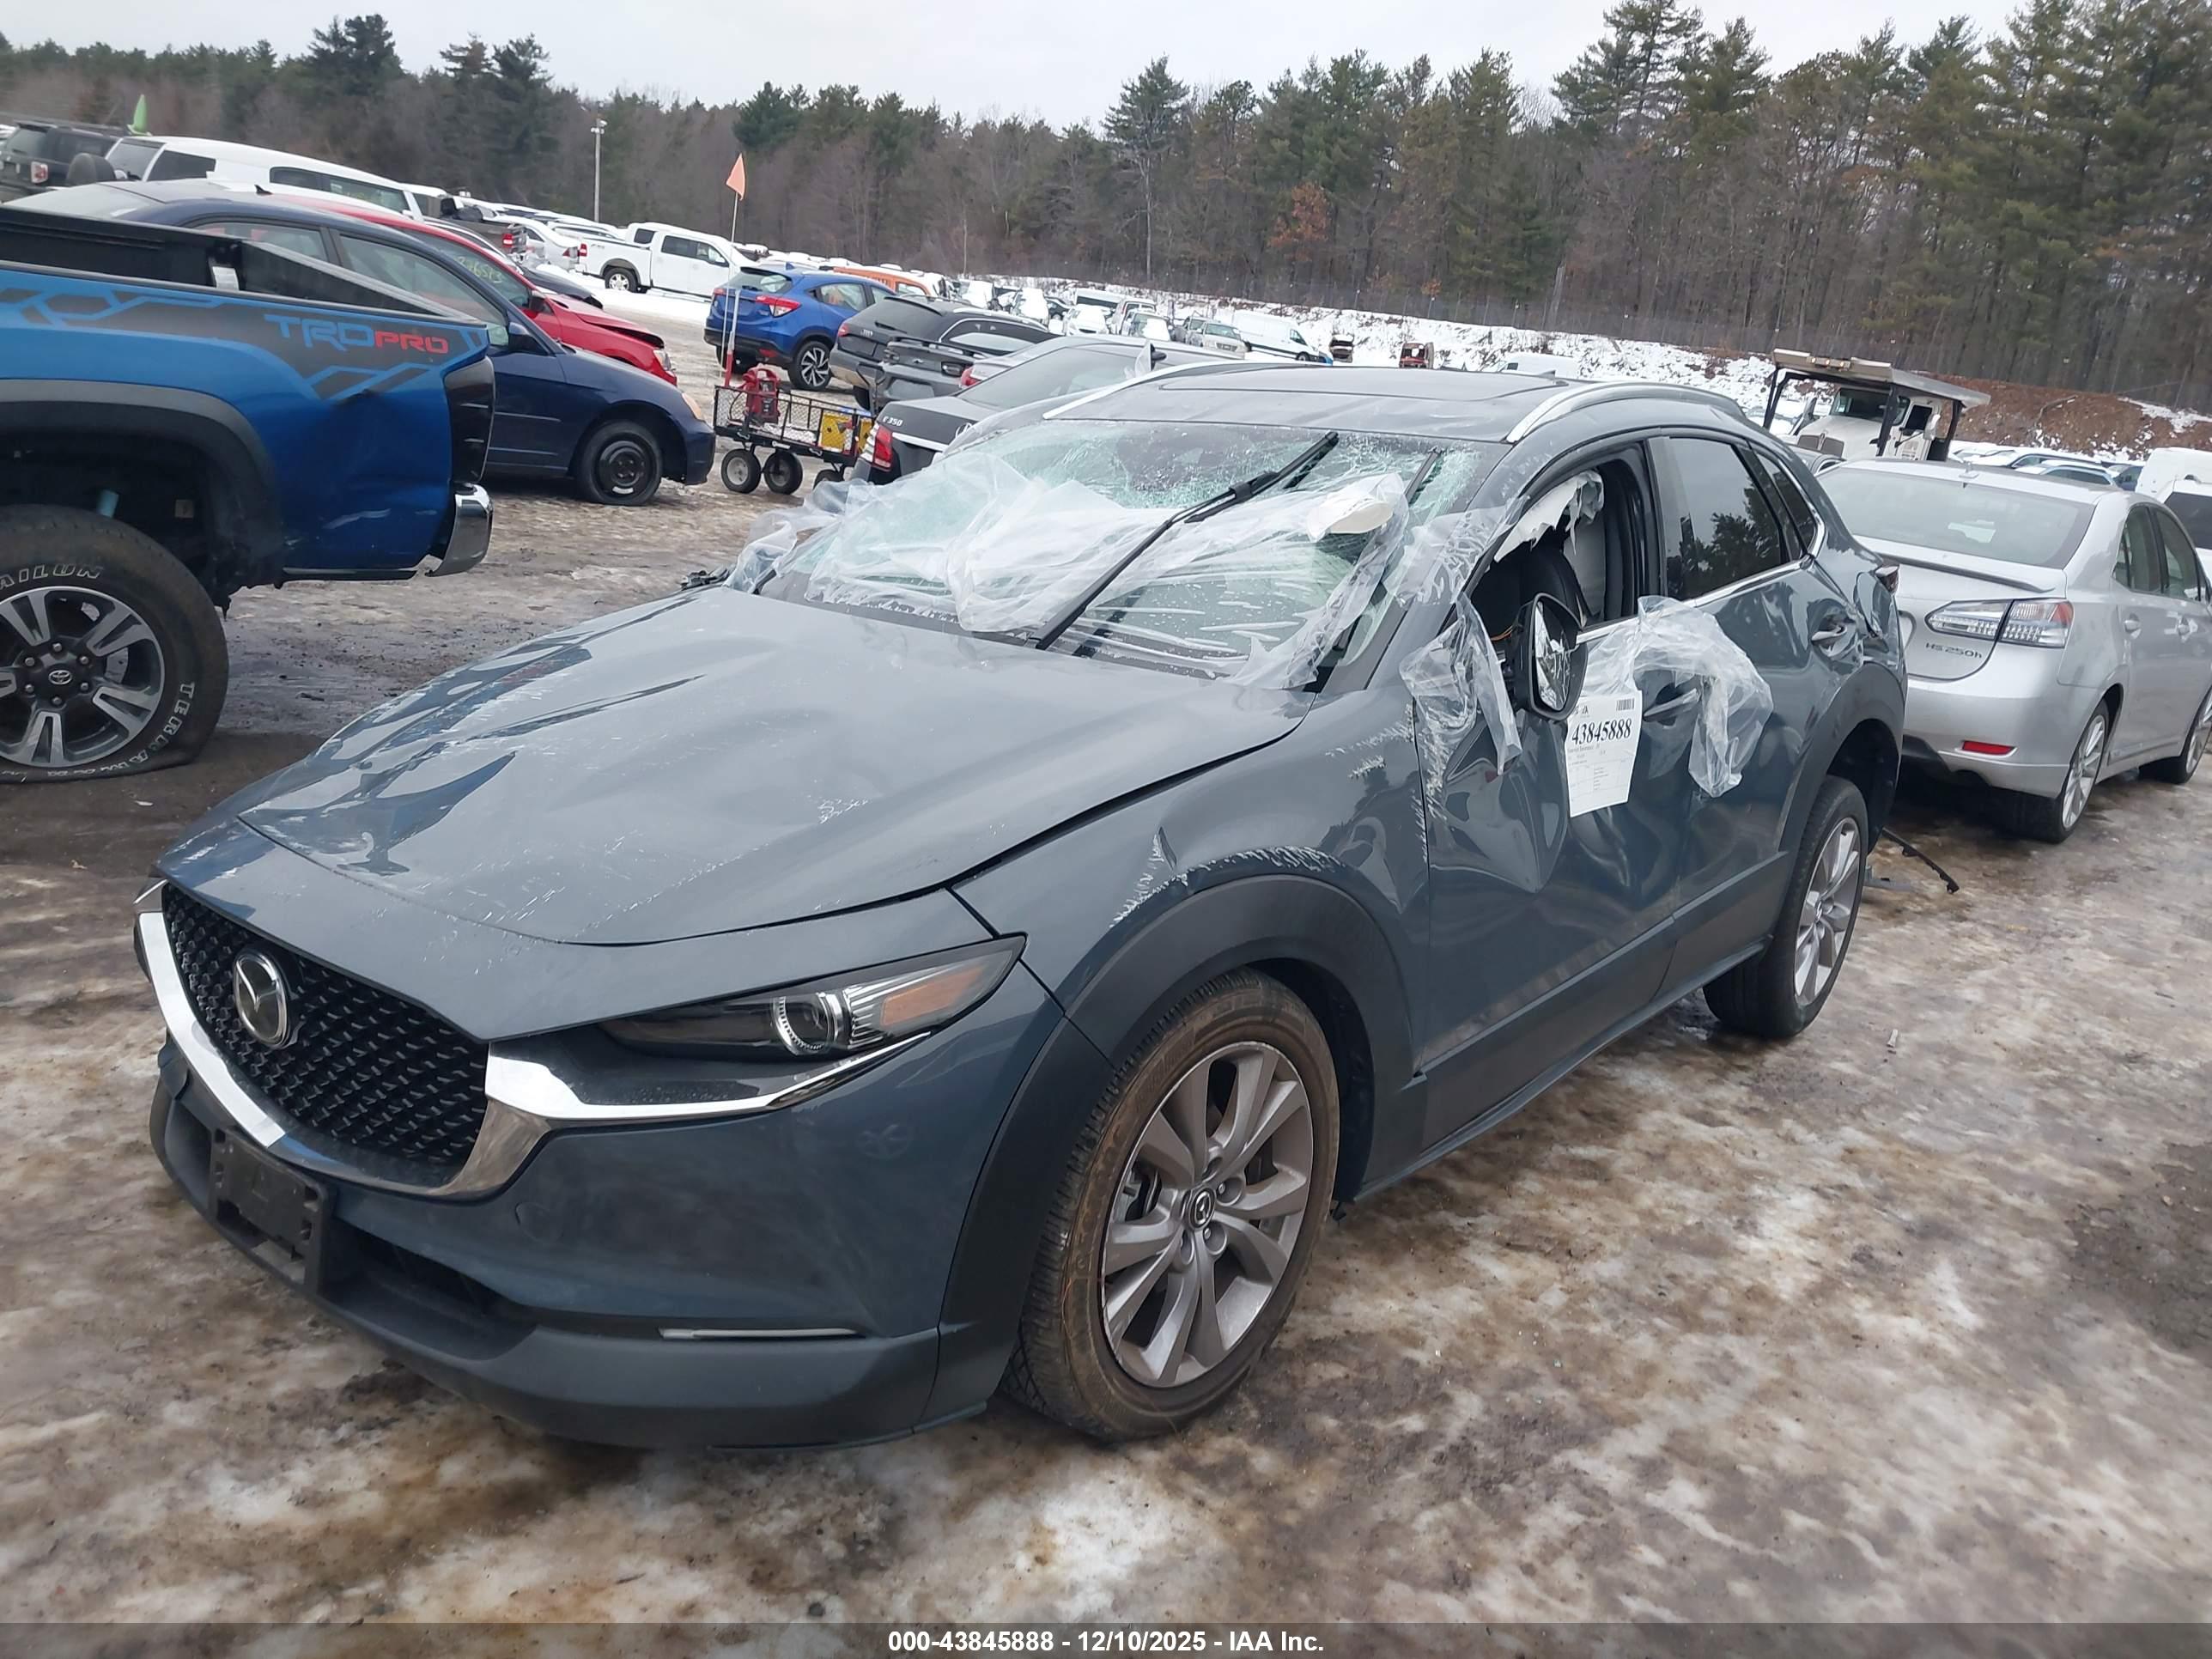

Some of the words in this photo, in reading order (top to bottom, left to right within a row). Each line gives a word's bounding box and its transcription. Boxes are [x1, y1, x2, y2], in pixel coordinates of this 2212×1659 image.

[263, 313, 375, 352] TRD
[374, 330, 448, 355] PRO
[887, 416, 903, 427] 350
[1571, 718, 1632, 744] 43845888
